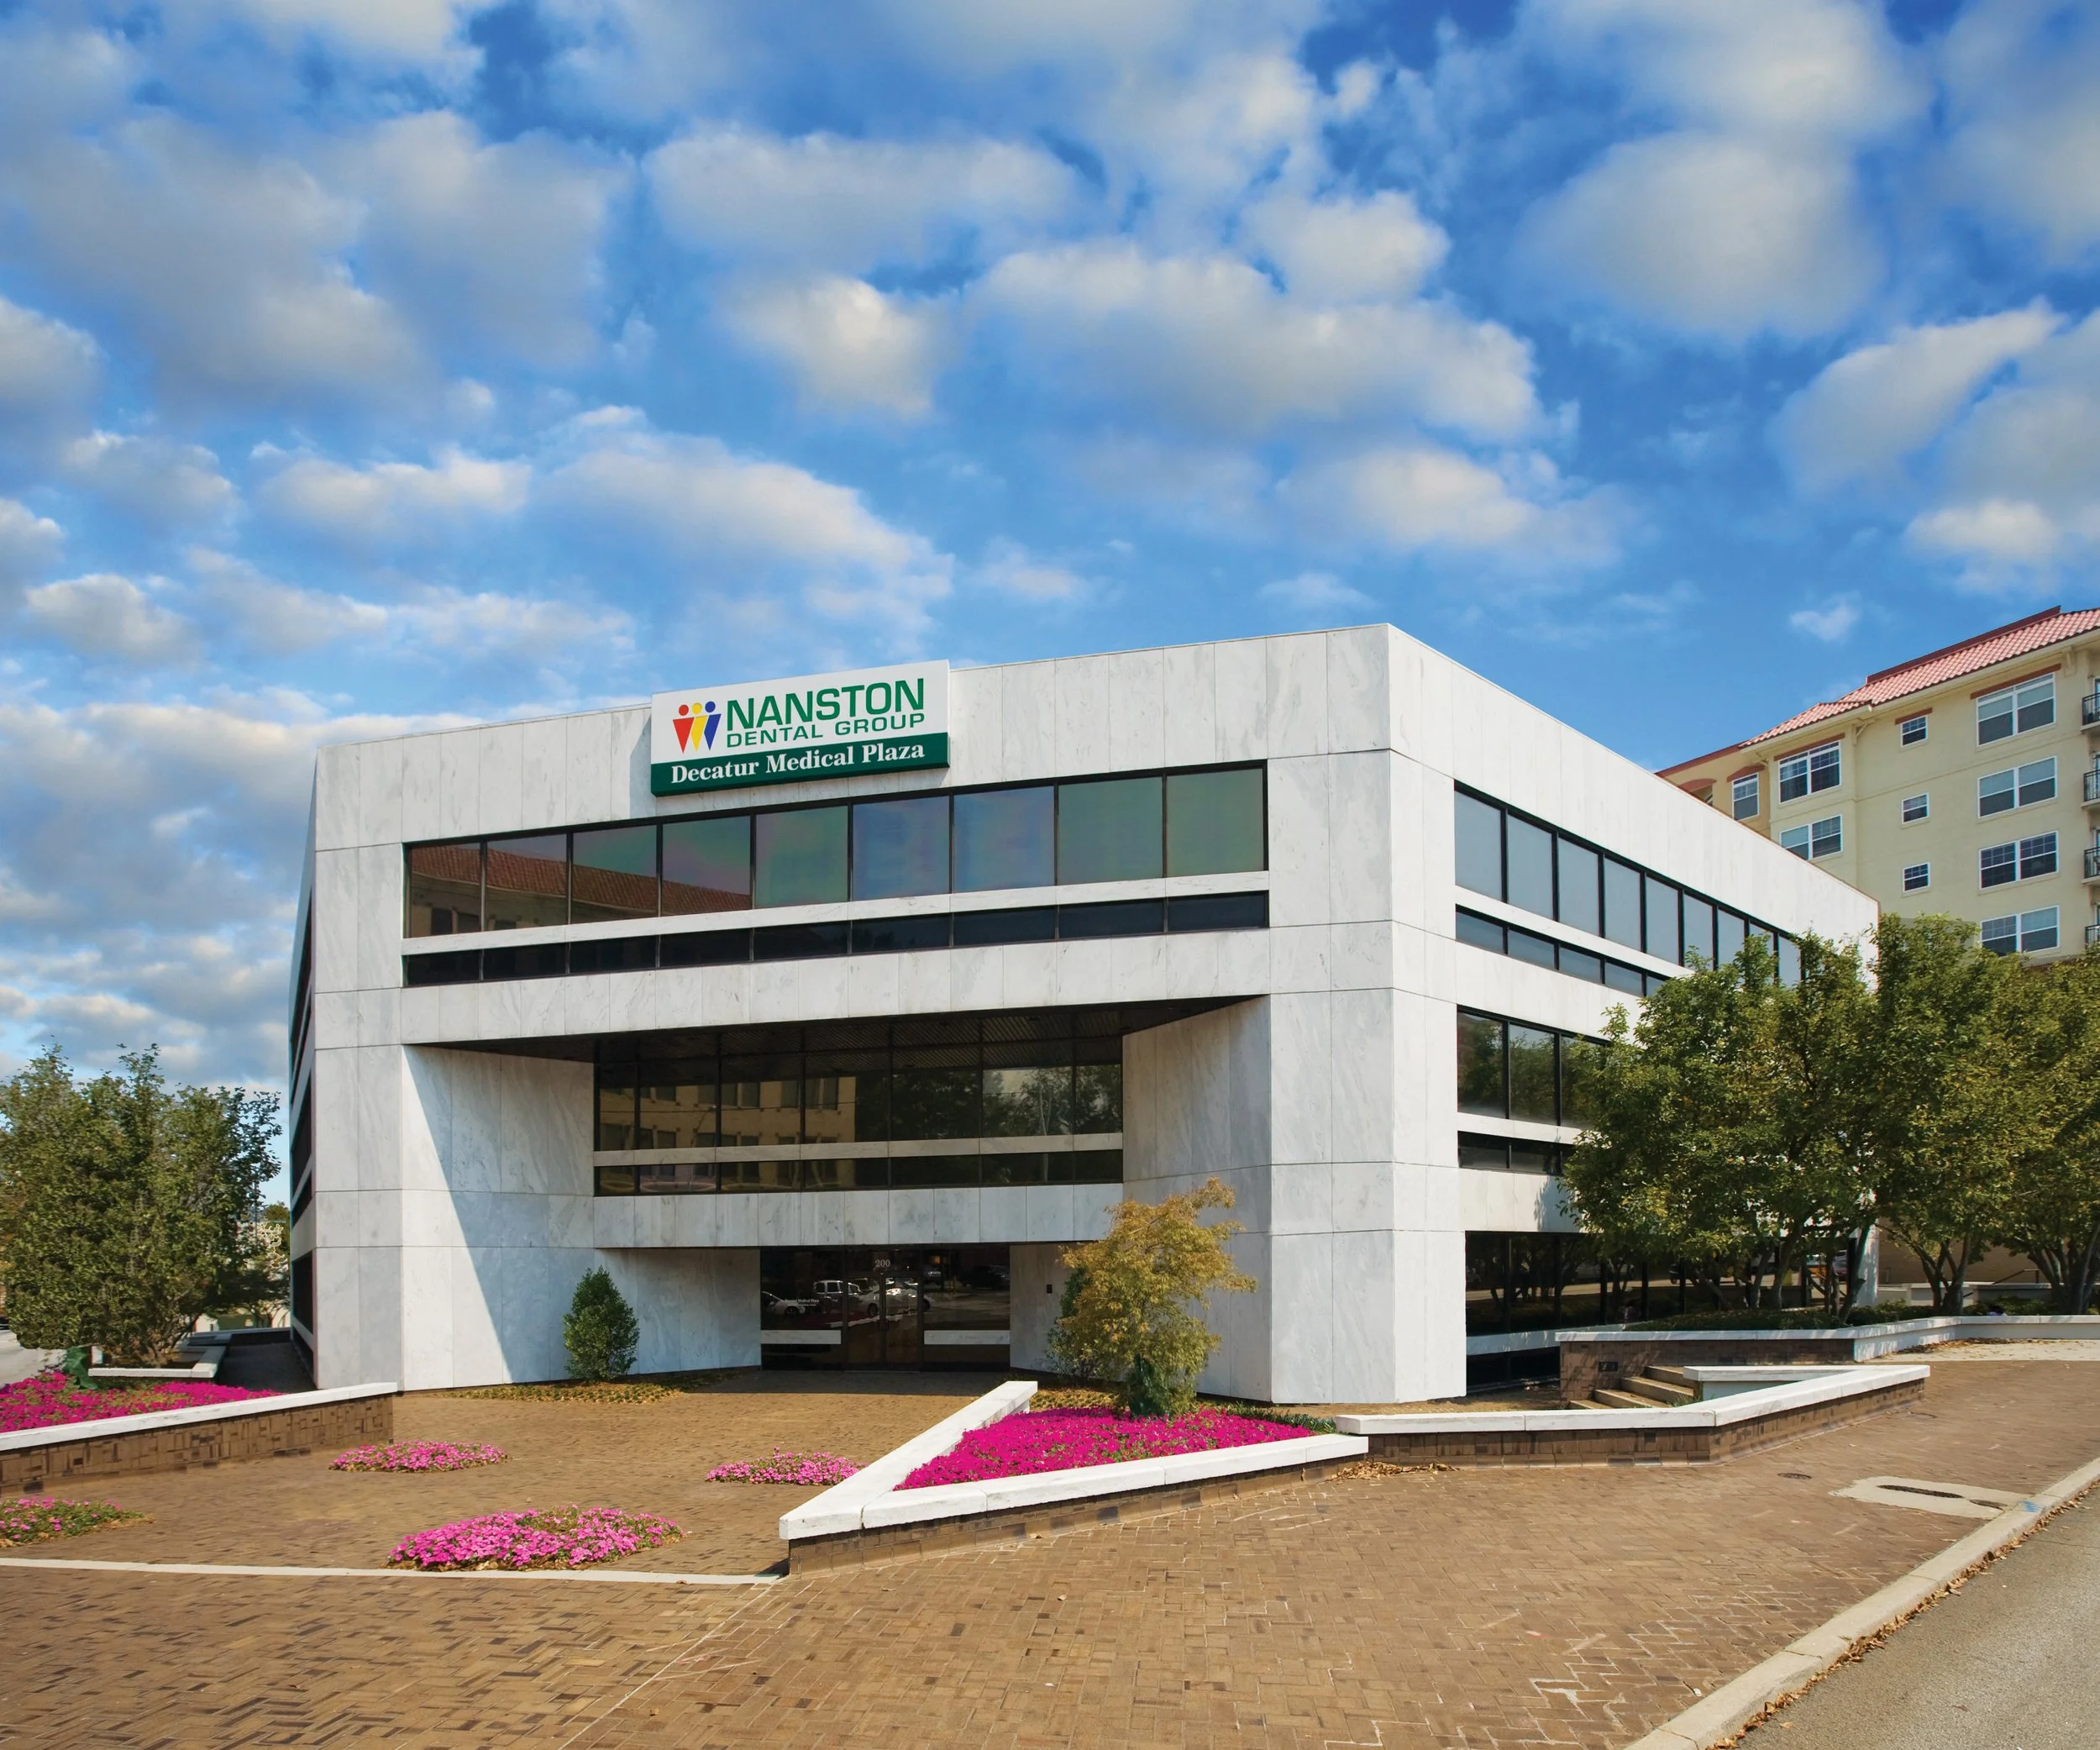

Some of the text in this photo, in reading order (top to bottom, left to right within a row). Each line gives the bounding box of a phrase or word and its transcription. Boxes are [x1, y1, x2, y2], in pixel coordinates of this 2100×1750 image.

[727, 678, 924, 731] NANSTON
[727, 712, 925, 748] DENTAL GROUP
[671, 742, 925, 784] Decatur Medical Plaza
[874, 1259, 891, 1268] 200
